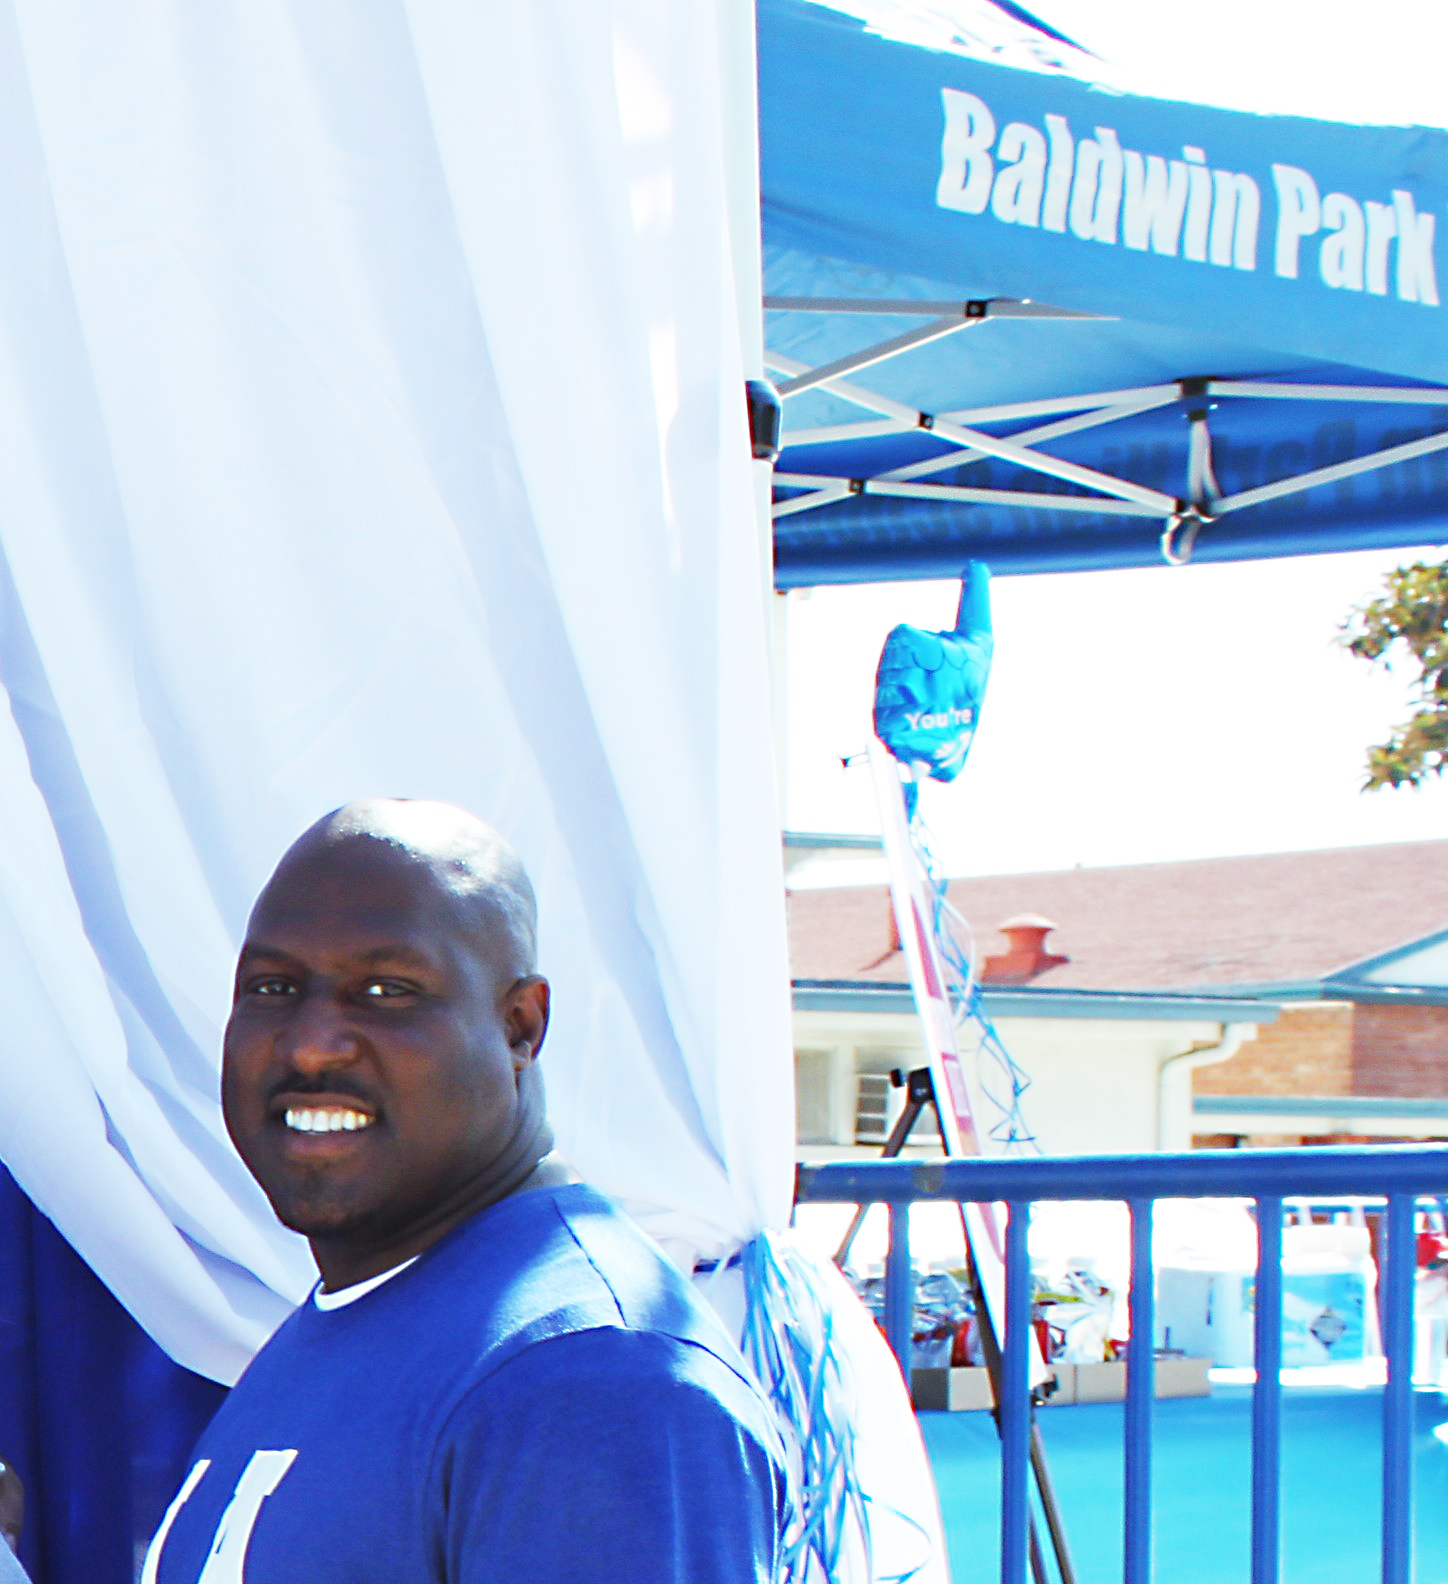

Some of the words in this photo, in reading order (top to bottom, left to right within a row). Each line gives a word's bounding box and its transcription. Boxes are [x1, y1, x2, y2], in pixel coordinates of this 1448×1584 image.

[936, 87, 1261, 271] Baldwin
[1272, 164, 1440, 305] Park
[904, 708, 972, 730] You're
